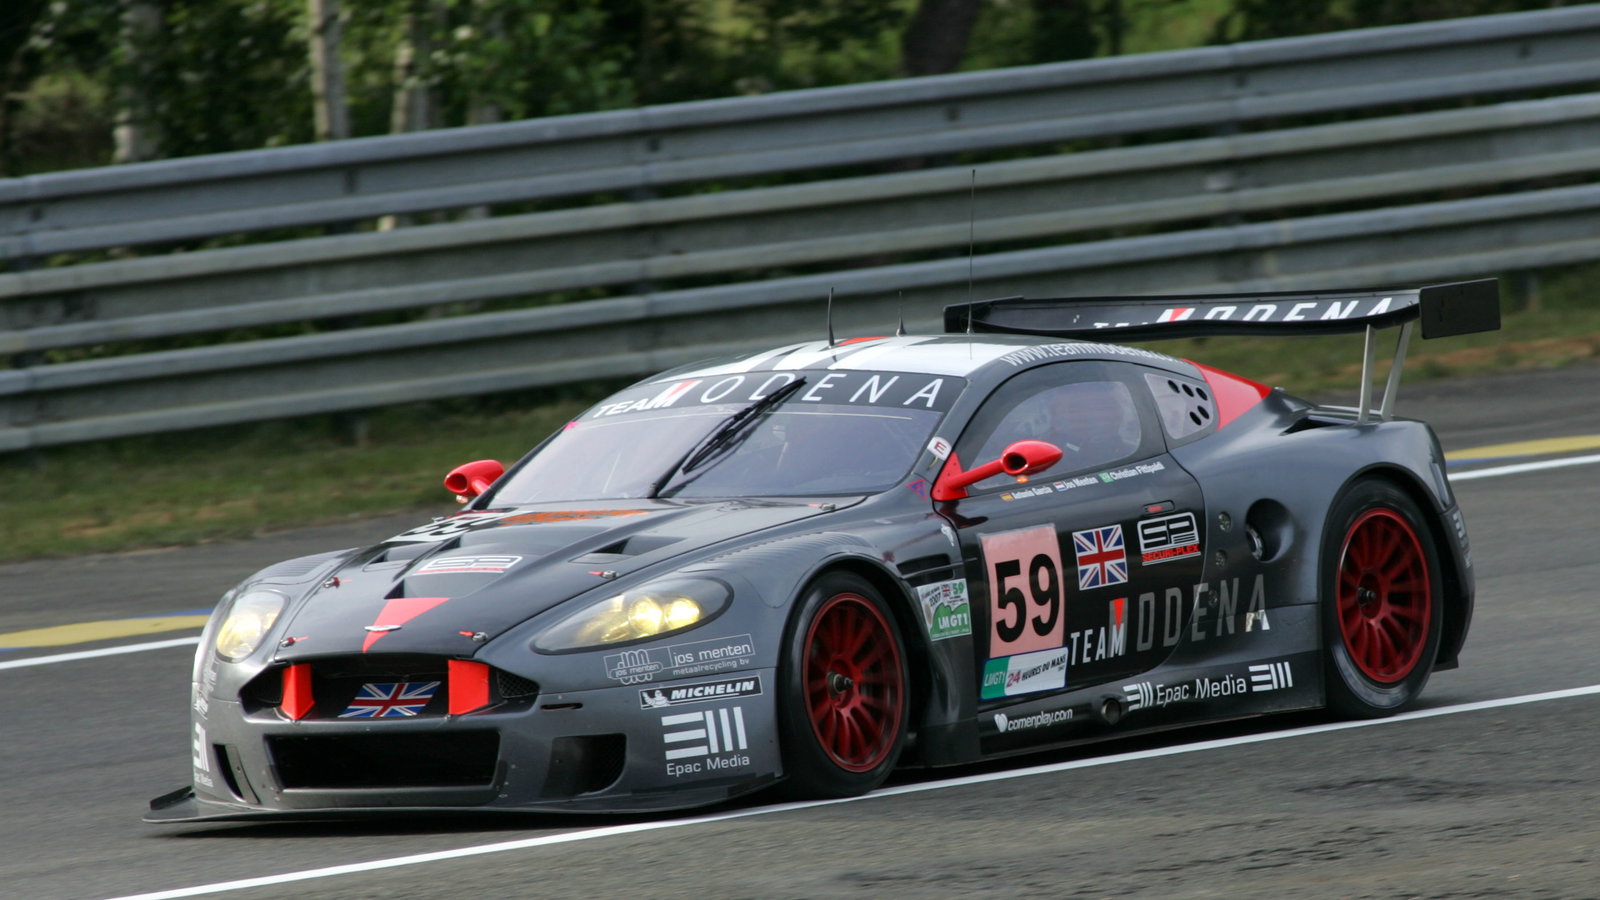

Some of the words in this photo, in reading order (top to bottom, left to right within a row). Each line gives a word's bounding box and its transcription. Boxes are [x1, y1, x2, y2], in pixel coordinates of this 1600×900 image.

[593, 397, 675, 418] TEAM
[1141, 544, 1199, 562] SECURI-PLEX
[952, 581, 965, 595] 59
[994, 553, 1061, 643] 59
[673, 652, 694, 667] jos
[699, 643, 751, 660] menten
[1070, 623, 1126, 666] TEAM
[630, 663, 659, 674] menten
[673, 659, 737, 676] metaalrecycling
[740, 657, 750, 665] bv
[1006, 670, 1022, 688] 24
[1022, 664, 1042, 681] HEURES
[1042, 660, 1051, 672] DU
[671, 680, 755, 700] MICHELIN
[1156, 683, 1190, 707] Epac
[1195, 674, 1247, 699] Media
[666, 762, 702, 777] Epac
[706, 754, 751, 770] Media
